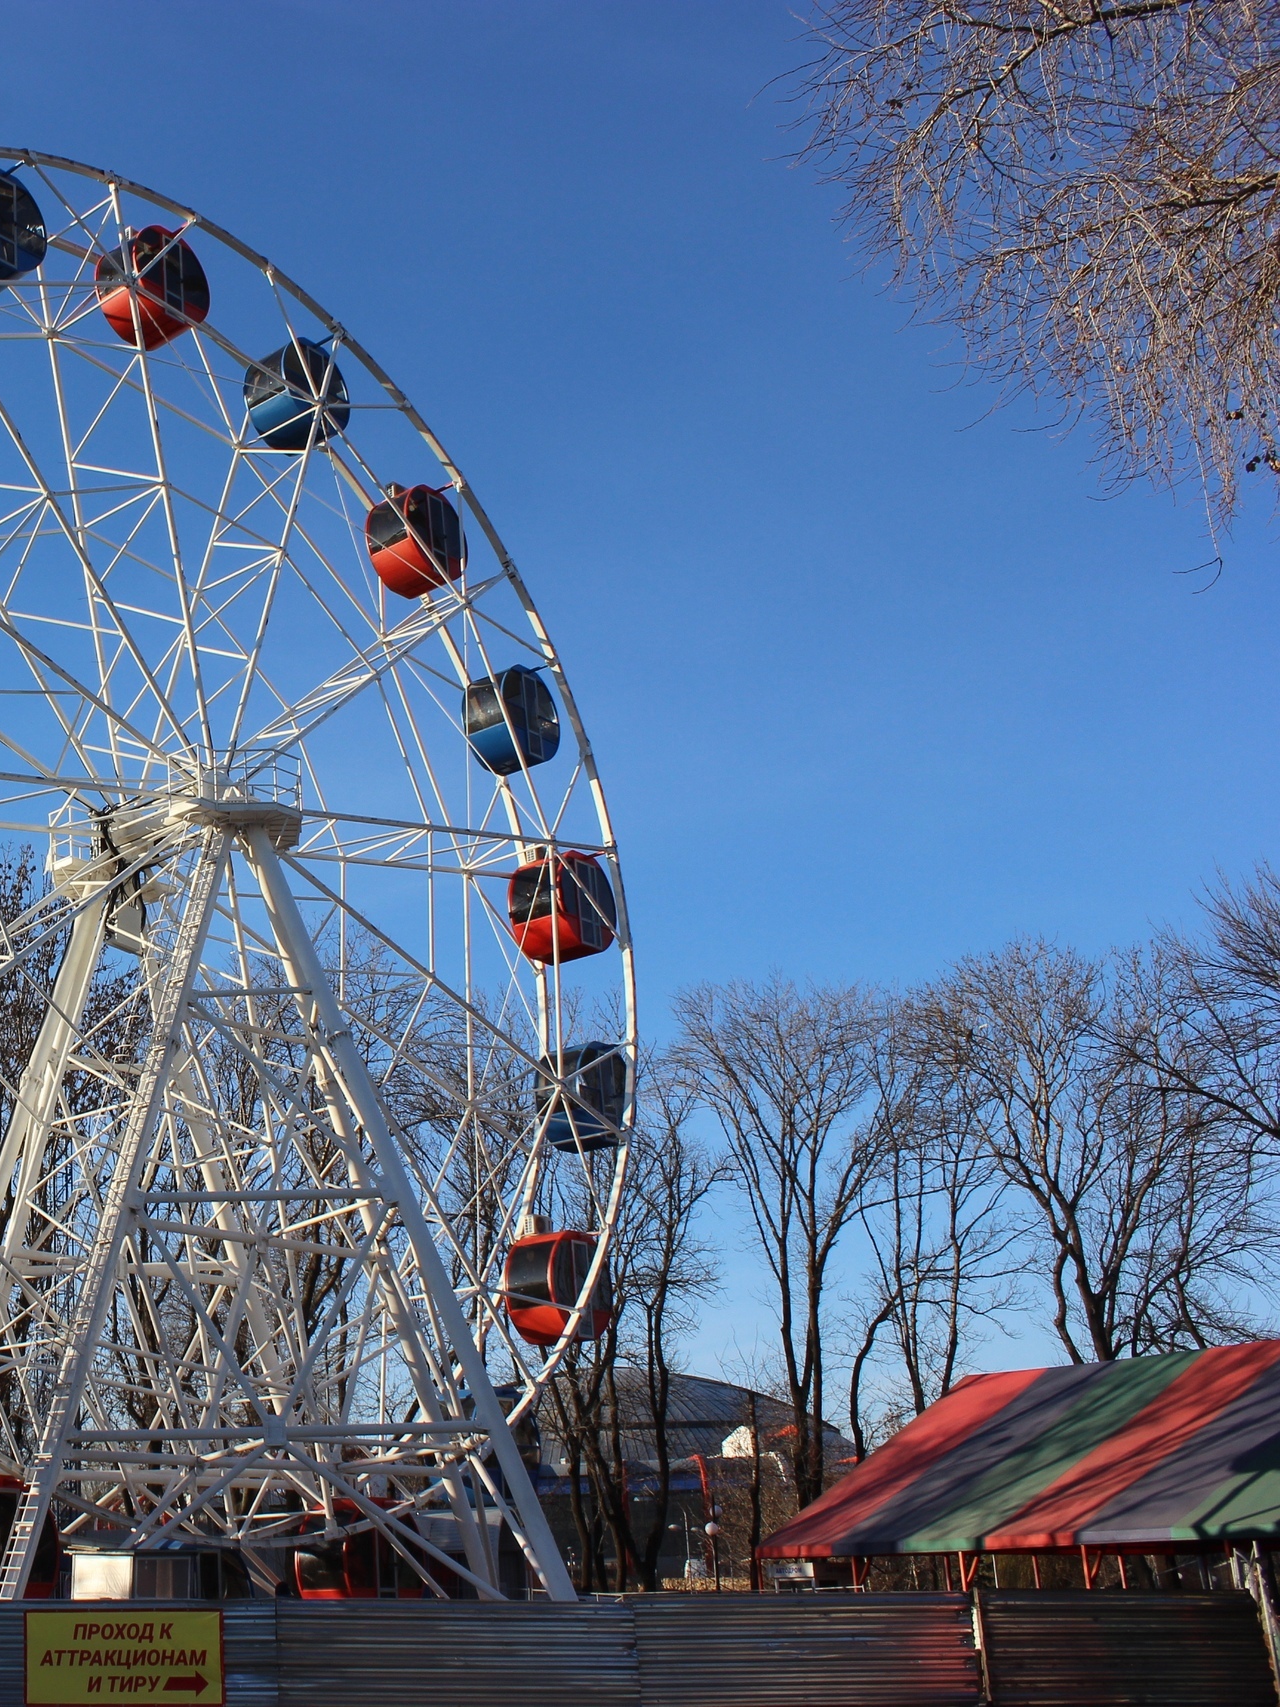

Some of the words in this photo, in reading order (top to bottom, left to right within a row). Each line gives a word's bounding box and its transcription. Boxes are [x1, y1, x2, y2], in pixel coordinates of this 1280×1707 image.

[73, 1623, 154, 1643] ПРОХОД
[159, 1623, 174, 1640] К
[40, 1649, 207, 1670] АТТРАКЦИОНАМ
[87, 1676, 102, 1693] И
[107, 1675, 161, 1693] ТИРУ
